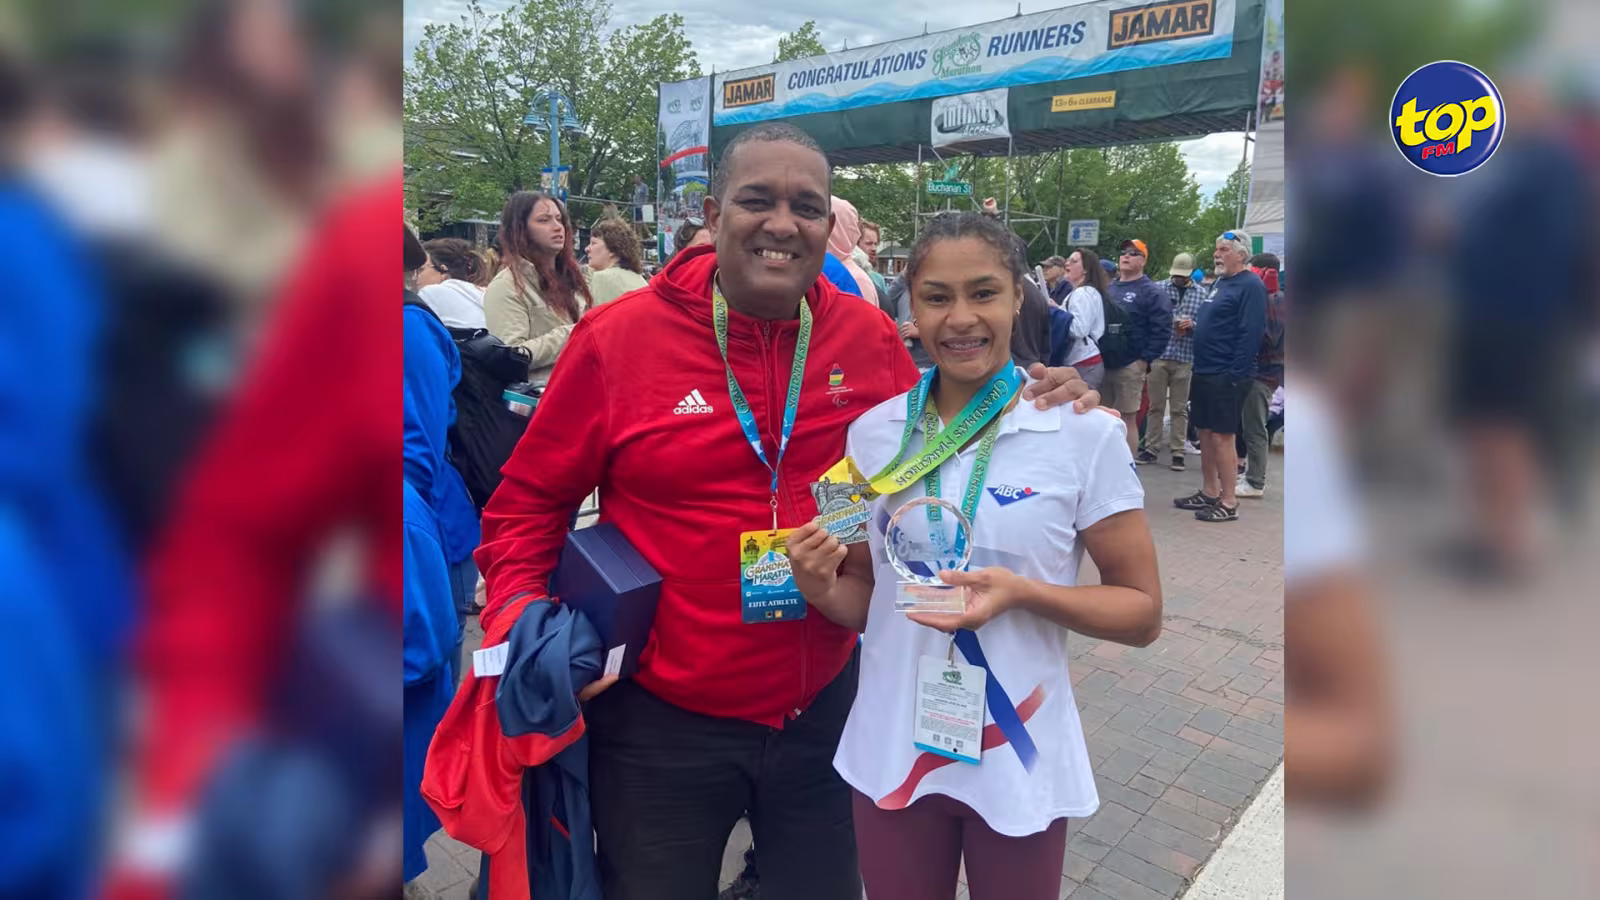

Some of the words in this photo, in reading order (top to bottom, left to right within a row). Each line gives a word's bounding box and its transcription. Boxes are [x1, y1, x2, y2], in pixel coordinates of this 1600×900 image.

[1114, 4, 1210, 41] JAMAR
[788, 49, 928, 90] CONGRATULATIONS
[986, 20, 1087, 57] RUNNERS
[726, 78, 772, 103] JAMAR
[928, 182, 962, 193] Buchanan
[673, 404, 714, 415] adidas
[895, 435, 958, 486] MARATHON
[994, 485, 1022, 499] ABC
[746, 561, 791, 579] GRANDMA
[754, 569, 792, 585] MARATHO
[768, 598, 799, 606] ATHLETE
